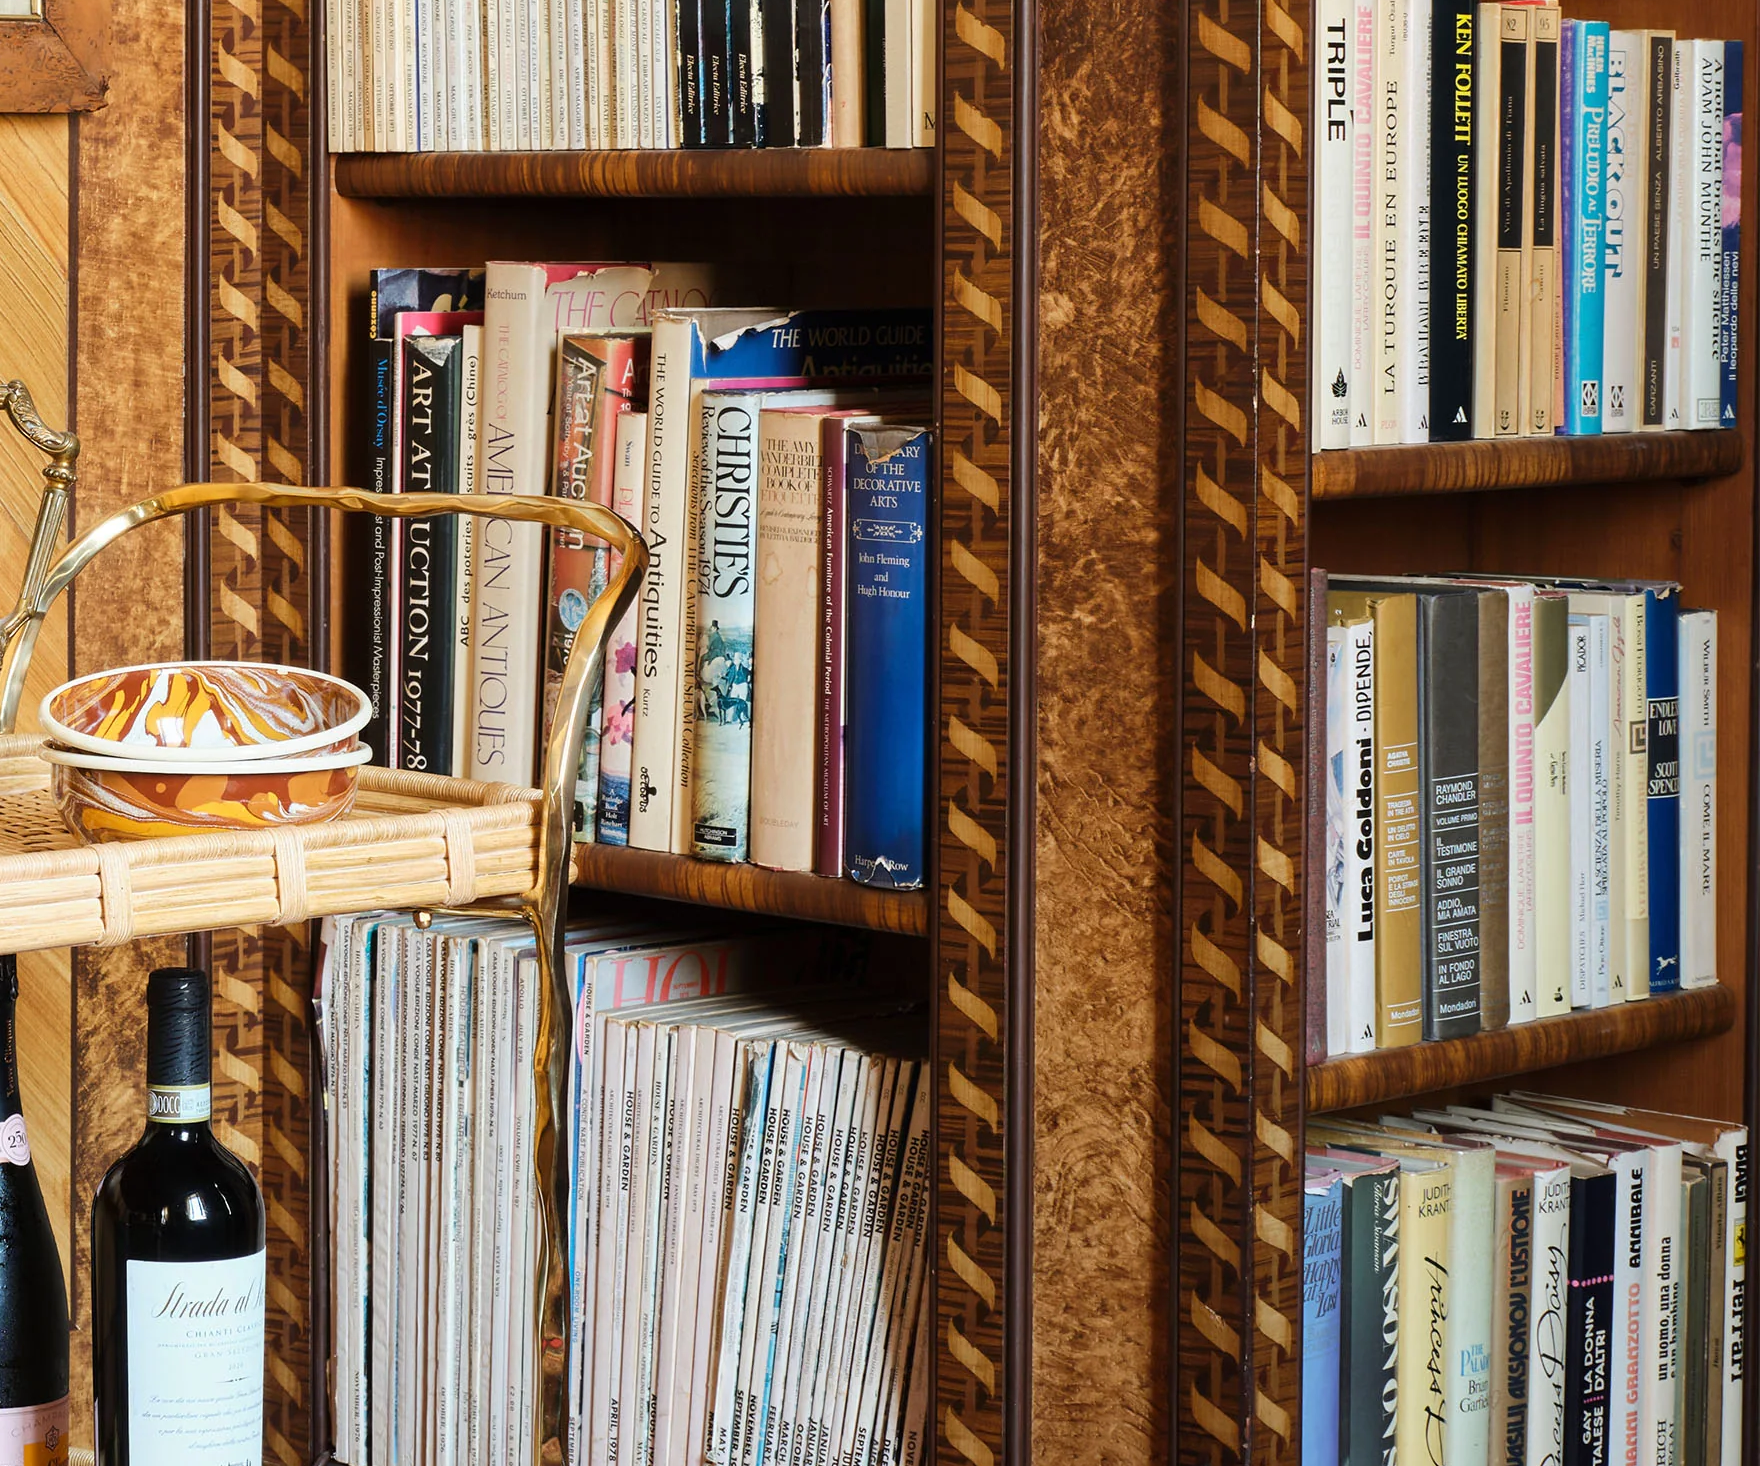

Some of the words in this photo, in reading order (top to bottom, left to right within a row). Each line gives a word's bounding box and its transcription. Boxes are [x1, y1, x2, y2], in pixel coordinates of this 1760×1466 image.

[1455, 13, 1473, 57] KEN
[686, 54, 696, 80] Electa
[712, 54, 721, 81] Electa
[738, 53, 748, 79] Electa
[1327, 17, 1346, 142] TRIPLE
[1355, 5, 1373, 125] CAVALIERE
[1701, 57, 1713, 114] ADAM
[687, 80, 697, 115] Editrice
[713, 81, 722, 116] Editrice
[739, 79, 749, 114] Editrice
[1454, 62, 1473, 146] FOLLETT
[1385, 80, 1398, 183] EUROPE
[1583, 103, 1606, 196] PRELUDIO
[1701, 120, 1713, 173] JOHN
[1354, 134, 1372, 217] QUINTO
[1457, 175, 1469, 221] LUOGO
[1700, 181, 1712, 262] MUNTHE
[1456, 223, 1469, 290] CHIAMATO
[1581, 212, 1603, 294] TERRORE
[486, 288, 528, 301] Ketchum
[1384, 239, 1397, 355] TURQUIE
[375, 358, 390, 397] Musée
[655, 353, 668, 383] THE
[411, 359, 433, 435] ART
[653, 386, 667, 448] WORLD
[372, 400, 389, 450] d'Orsay
[701, 404, 716, 457] Review
[410, 439, 433, 490] AT
[651, 449, 664, 500] GUIDE
[852, 478, 922, 493] DECORATIVE
[886, 463, 905, 476] THE
[649, 504, 661, 525] TO
[712, 405, 753, 600] CHRISTIE'S
[869, 494, 899, 510] ARTS
[698, 499, 713, 556] Season
[826, 507, 835, 550] American
[697, 558, 712, 598] 1974
[826, 551, 835, 595] Furniture
[876, 553, 911, 569] Fleming
[371, 551, 385, 644] Post-Impressionist
[642, 528, 668, 678] Antiquities
[857, 583, 877, 599] Hugh
[878, 585, 911, 600] Honour
[459, 614, 471, 648] ABC
[824, 625, 833, 663] Colonial
[1514, 600, 1533, 716] CAVALIERE
[370, 645, 384, 719] Masterpieces
[476, 601, 511, 767] ANTIQUES
[642, 687, 652, 718] Kurtz
[402, 668, 429, 770] 1977-78
[679, 727, 696, 789] Collection
[1514, 722, 1534, 804] QUINTO
[1355, 737, 1374, 861] Goldoni
[1435, 779, 1475, 797] RAYMOND
[1435, 790, 1478, 807] CHANDLER
[1436, 841, 1478, 858] TESTIMONE
[1445, 862, 1477, 877] GRANDE
[1357, 866, 1374, 943] Luca
[1436, 874, 1464, 889] SONNO
[1437, 929, 1474, 945] FINESTRA
[1451, 968, 1473, 984] LAGO
[1439, 996, 1478, 1015] Mondadori
[765, 1107, 778, 1144] HOUSE
[779, 1108, 792, 1145] HOUSE
[800, 1116, 814, 1155] HOUSE
[830, 1128, 844, 1168] HOUSE
[620, 1145, 633, 1191] GARDEN
[884, 1129, 899, 1169] HOUSE
[904, 1136, 920, 1176] HOUSE
[724, 1162, 737, 1211] GARDEN
[758, 1158, 772, 1205] GARDEN
[772, 1159, 786, 1207] GARDEN
[793, 1171, 807, 1219] GARDEN
[807, 1169, 821, 1217] GARDEN
[822, 1184, 837, 1233] GARDEN
[874, 1185, 890, 1234] GARDEN
[893, 1193, 910, 1242] GARDEN
[1382, 1176, 1400, 1371] SWANSON
[1659, 1235, 1673, 1281] donna
[149, 1280, 230, 1321] Strada
[1660, 1284, 1672, 1313] una
[185, 1327, 234, 1340] CHIANTI
[1584, 1295, 1596, 1367] DONNA
[1583, 1370, 1595, 1395] LA
[1594, 1329, 1607, 1393] D'ALTRI
[1582, 1409, 1594, 1445] GAY
